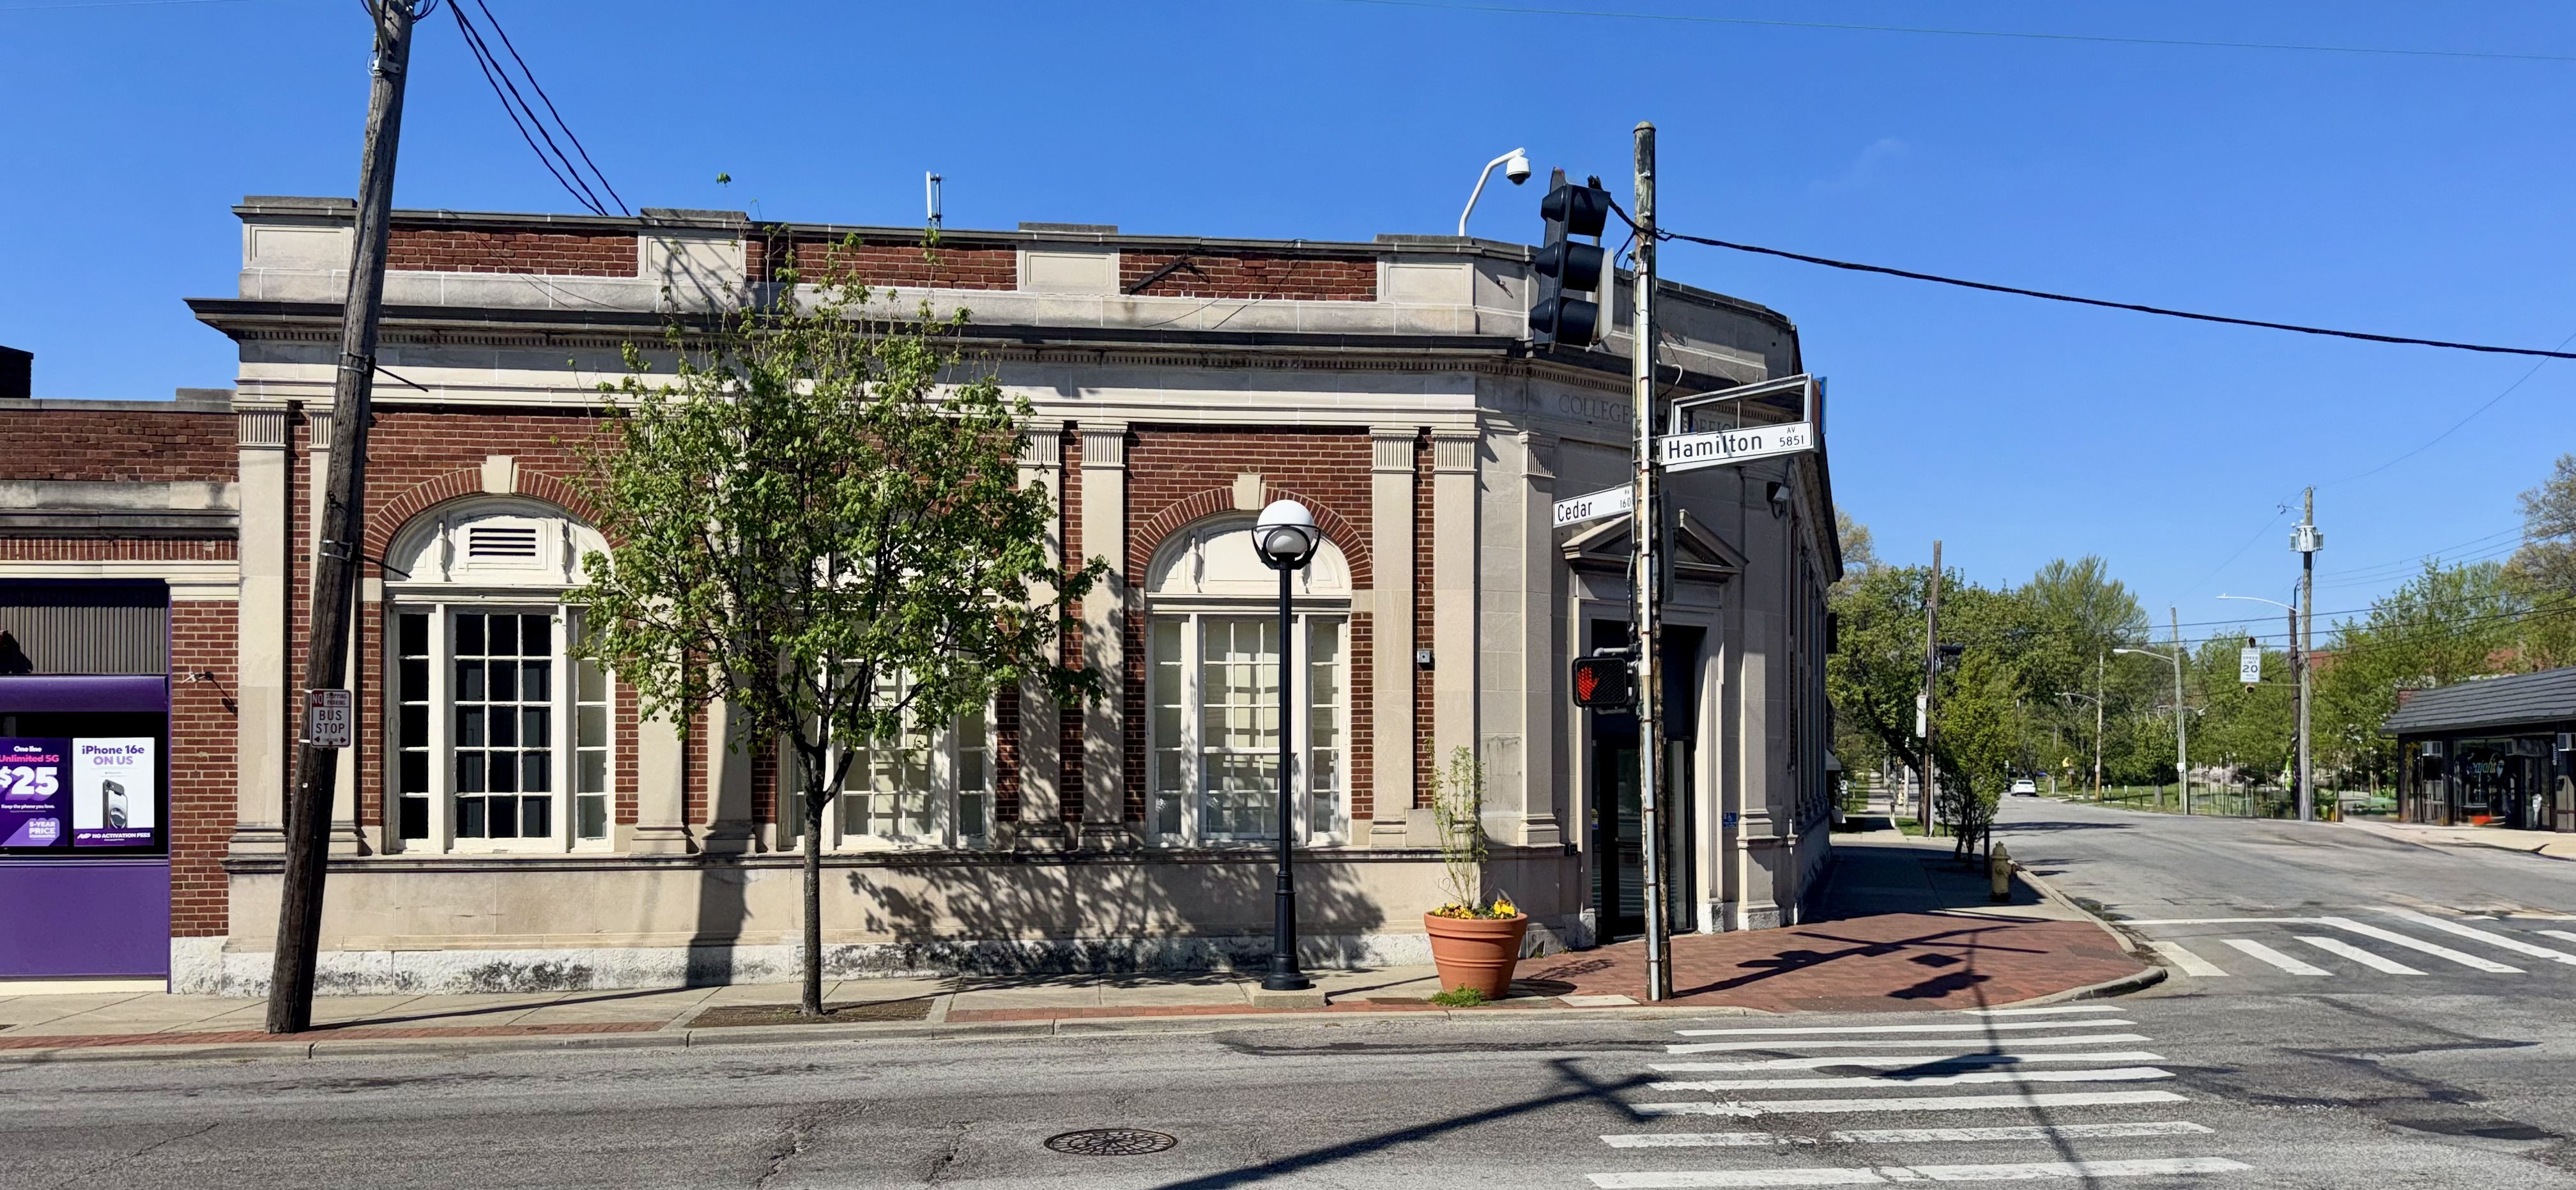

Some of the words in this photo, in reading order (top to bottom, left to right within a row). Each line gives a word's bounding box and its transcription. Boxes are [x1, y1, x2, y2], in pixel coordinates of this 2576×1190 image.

[1559, 394, 1630, 424] COLLEGE
[1669, 434, 1762, 459] Hamilton
[1779, 435, 1804, 447] 5851
[1558, 500, 1592, 522] Cedar
[2242, 665, 2258, 673] 20
[312, 693, 323, 704] NO
[319, 710, 342, 721] BUS
[316, 723, 345, 734] STOP
[82, 745, 123, 754] iPhone
[125, 745, 145, 754] 16e
[0, 754, 44, 762] Unlimited
[45, 754, 59, 762] 5G
[93, 756, 114, 765] ON
[116, 755, 134, 765] US
[0, 766, 59, 795] $25
